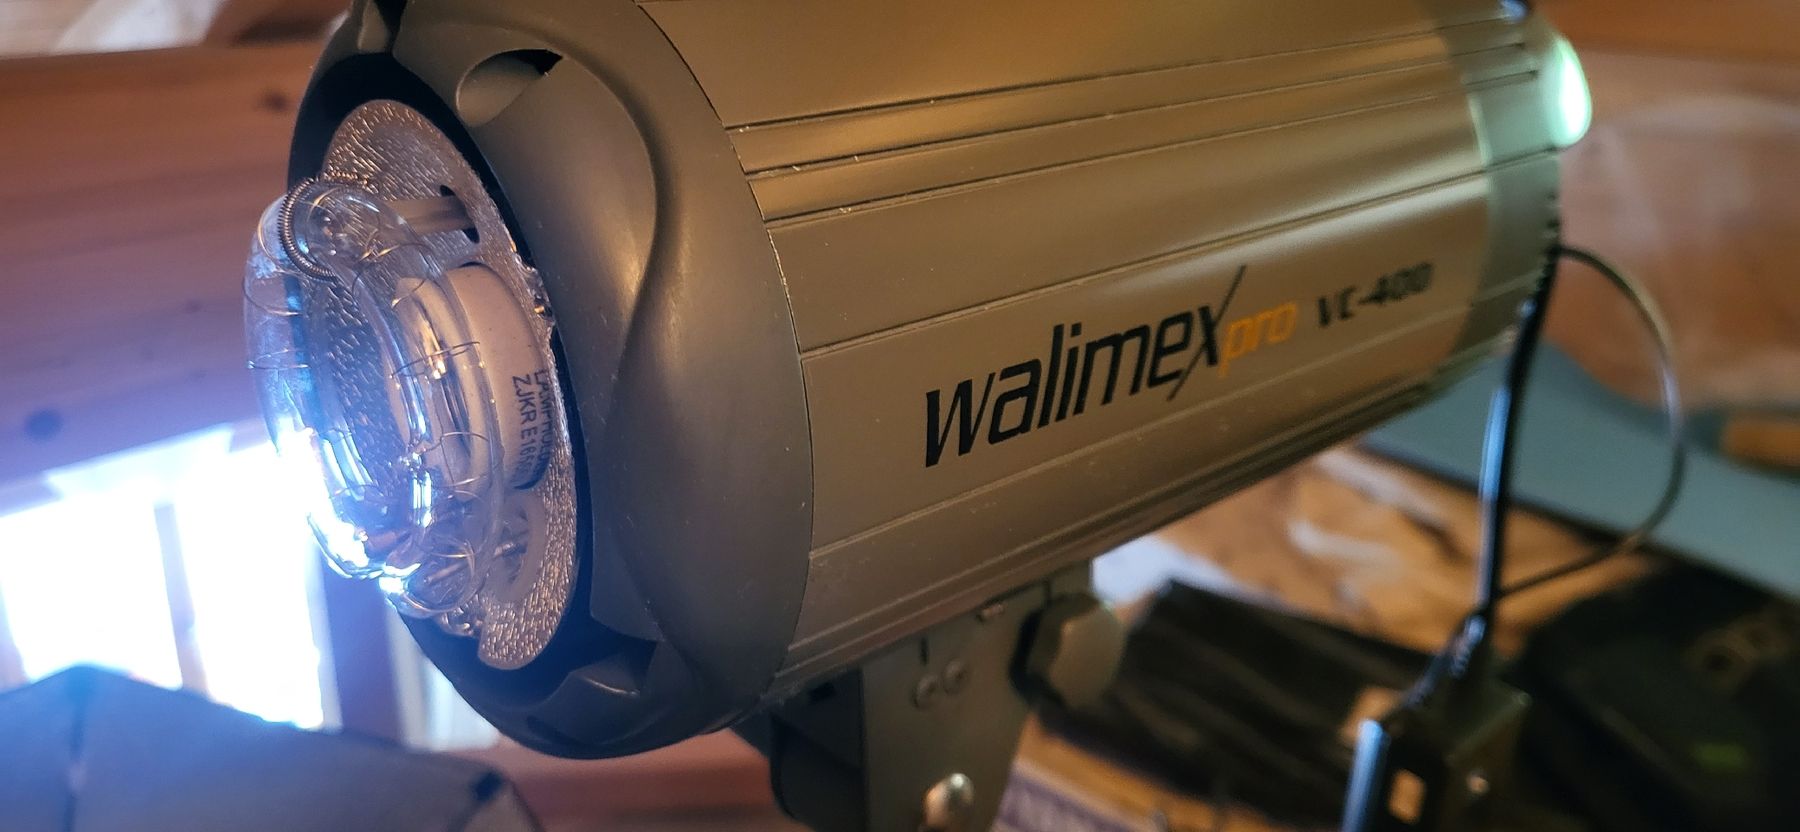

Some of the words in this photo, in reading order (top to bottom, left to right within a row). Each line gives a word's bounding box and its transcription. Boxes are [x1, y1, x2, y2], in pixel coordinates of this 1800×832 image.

[512, 374, 537, 425] ZJKR
[925, 265, 1246, 467] walimex
[1218, 303, 1297, 378] pro
